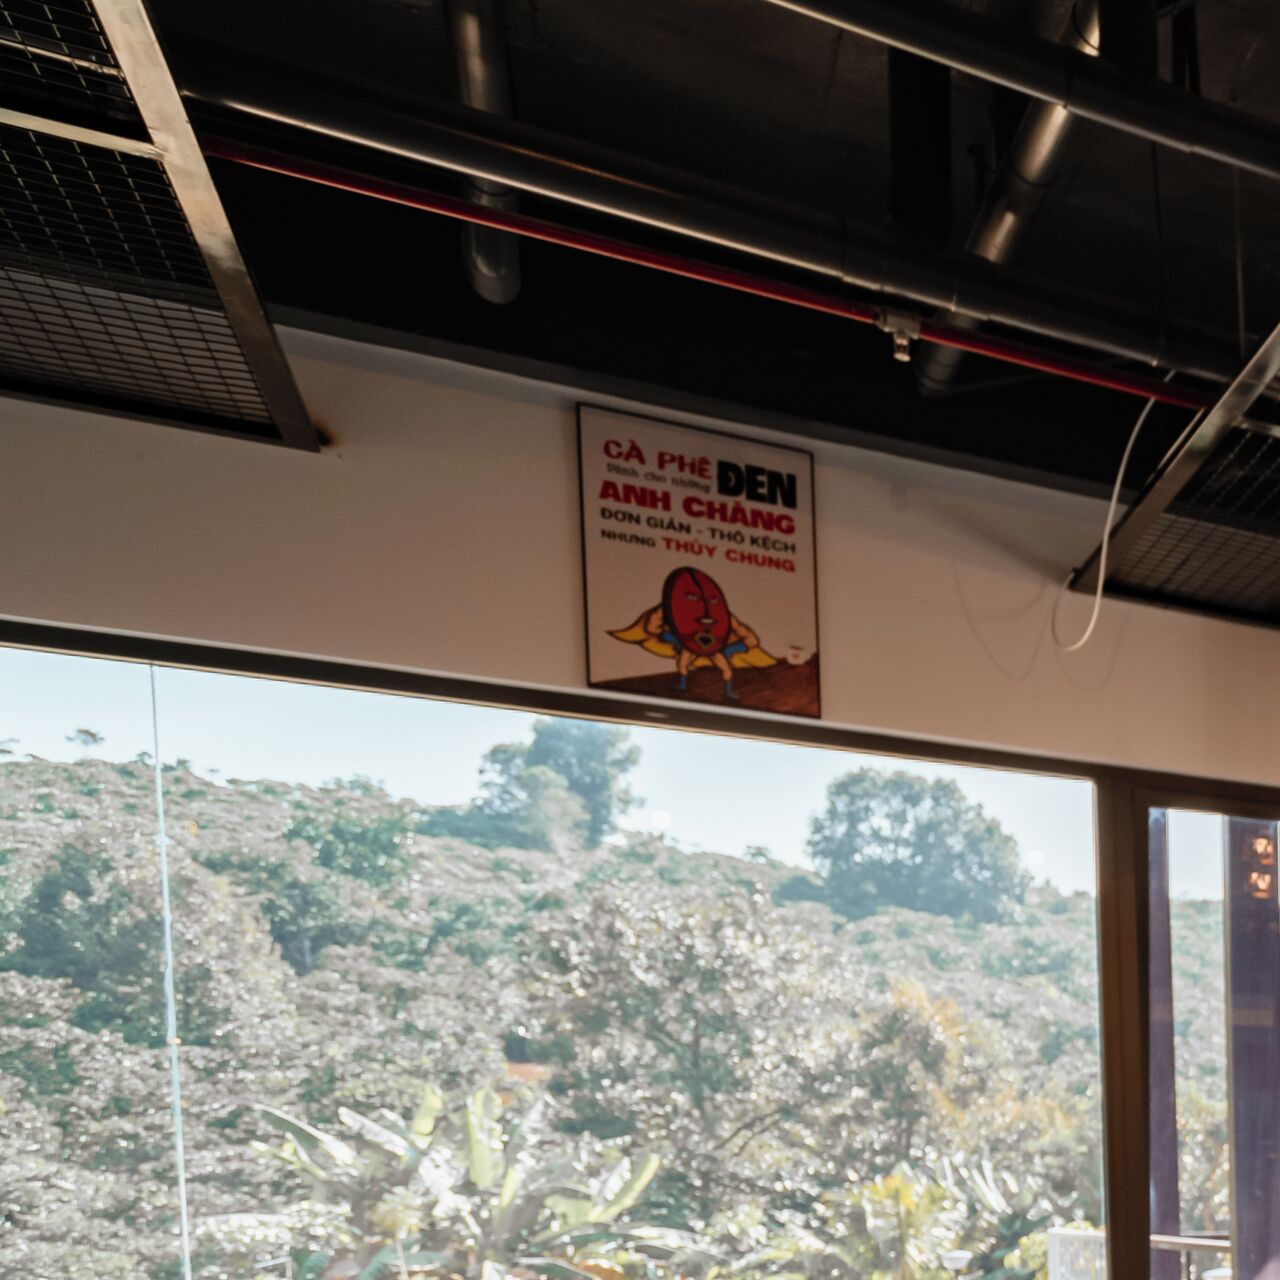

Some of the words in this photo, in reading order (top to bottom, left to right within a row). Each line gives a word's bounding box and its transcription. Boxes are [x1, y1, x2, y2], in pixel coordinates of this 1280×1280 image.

[603, 439, 646, 465] CÀ
[657, 451, 713, 480] PHÊ
[717, 460, 797, 509] ĐEN
[643, 471, 667, 484] cho
[599, 480, 672, 511] ANH
[682, 496, 796, 535] CHÀNG
[600, 507, 641, 525] ĐƠN
[601, 529, 657, 548] NHƯNG
[725, 549, 797, 573] CHUNG
